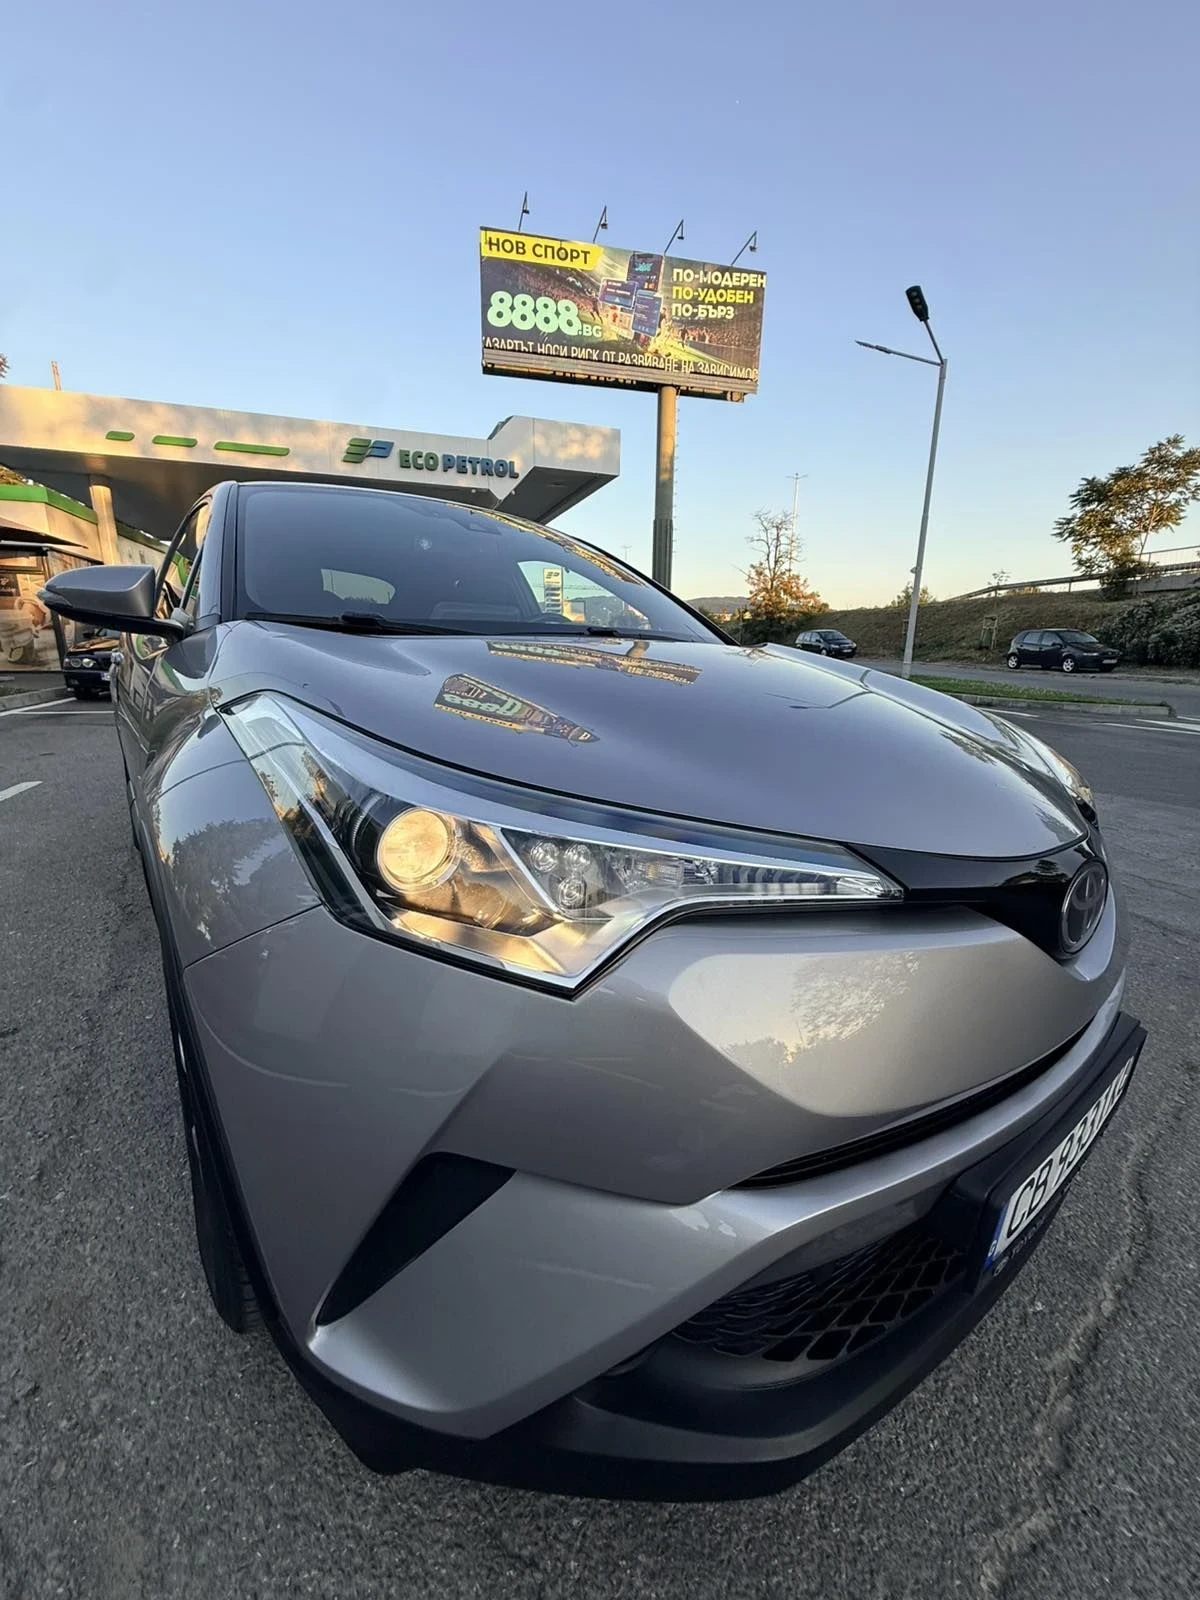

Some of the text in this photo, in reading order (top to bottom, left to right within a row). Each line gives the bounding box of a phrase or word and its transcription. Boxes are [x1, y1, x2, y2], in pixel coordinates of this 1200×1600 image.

[488, 236, 591, 265] НОВ СПОРТ
[672, 268, 767, 288] ПО-МОДЕРЕН
[672, 286, 754, 304] ПО-УДОБЕН
[671, 303, 735, 320] ПО-БЪРЗ
[398, 448, 520, 479] ECO PETROL
[1006, 1157, 1054, 1239] CB
